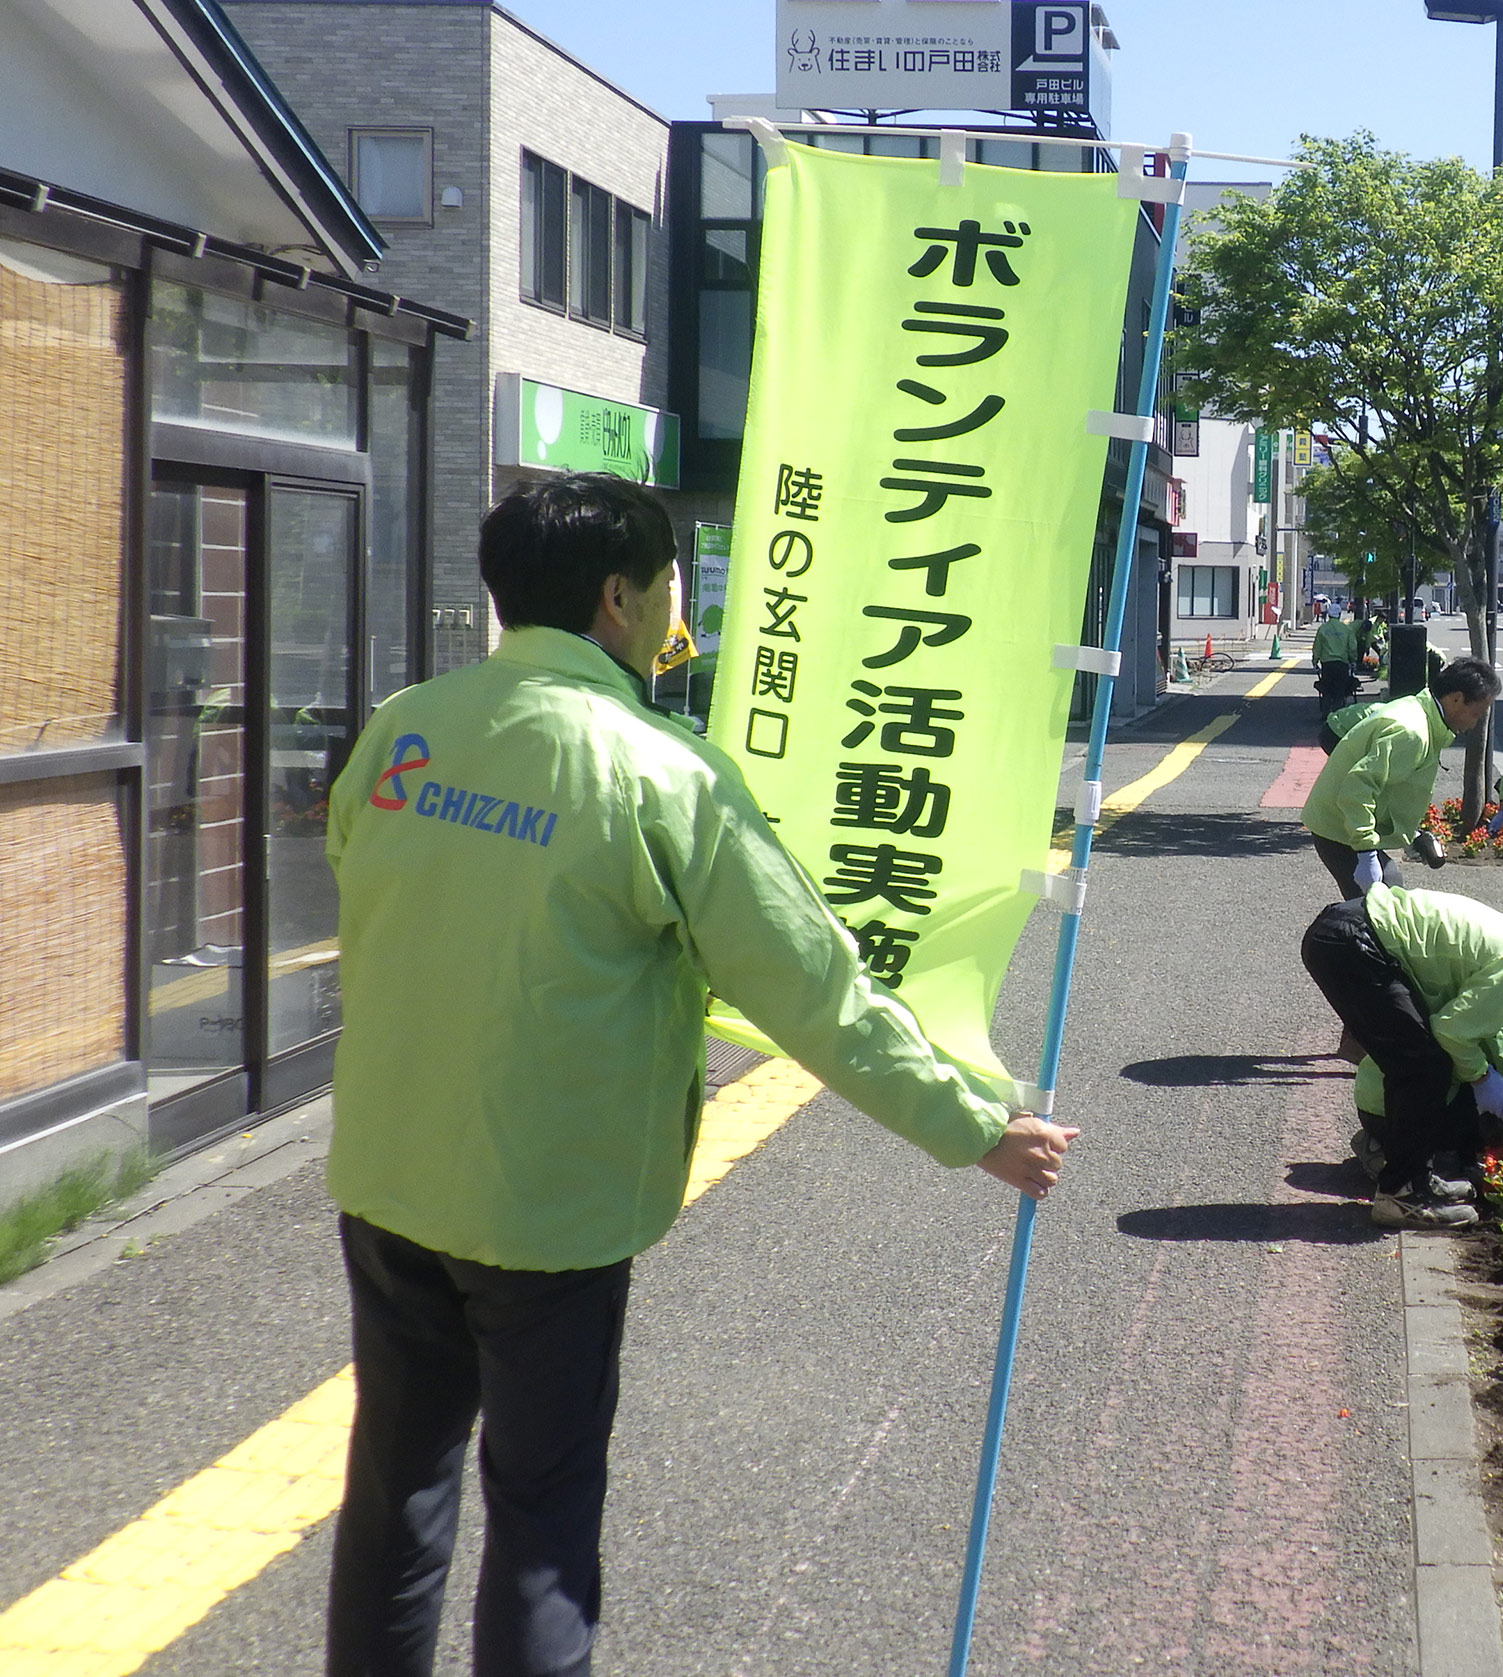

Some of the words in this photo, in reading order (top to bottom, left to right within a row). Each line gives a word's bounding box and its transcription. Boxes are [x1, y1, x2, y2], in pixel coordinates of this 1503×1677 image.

[1044, 11, 1076, 51] P
[1024, 92, 1084, 105] 専用駐車場
[1036, 79, 1084, 90] 戸田ビル
[745, 464, 823, 759] 陸の玄関口
[823, 219, 1032, 990] ボランティア活動実施
[415, 781, 558, 848] CHIZAKI
